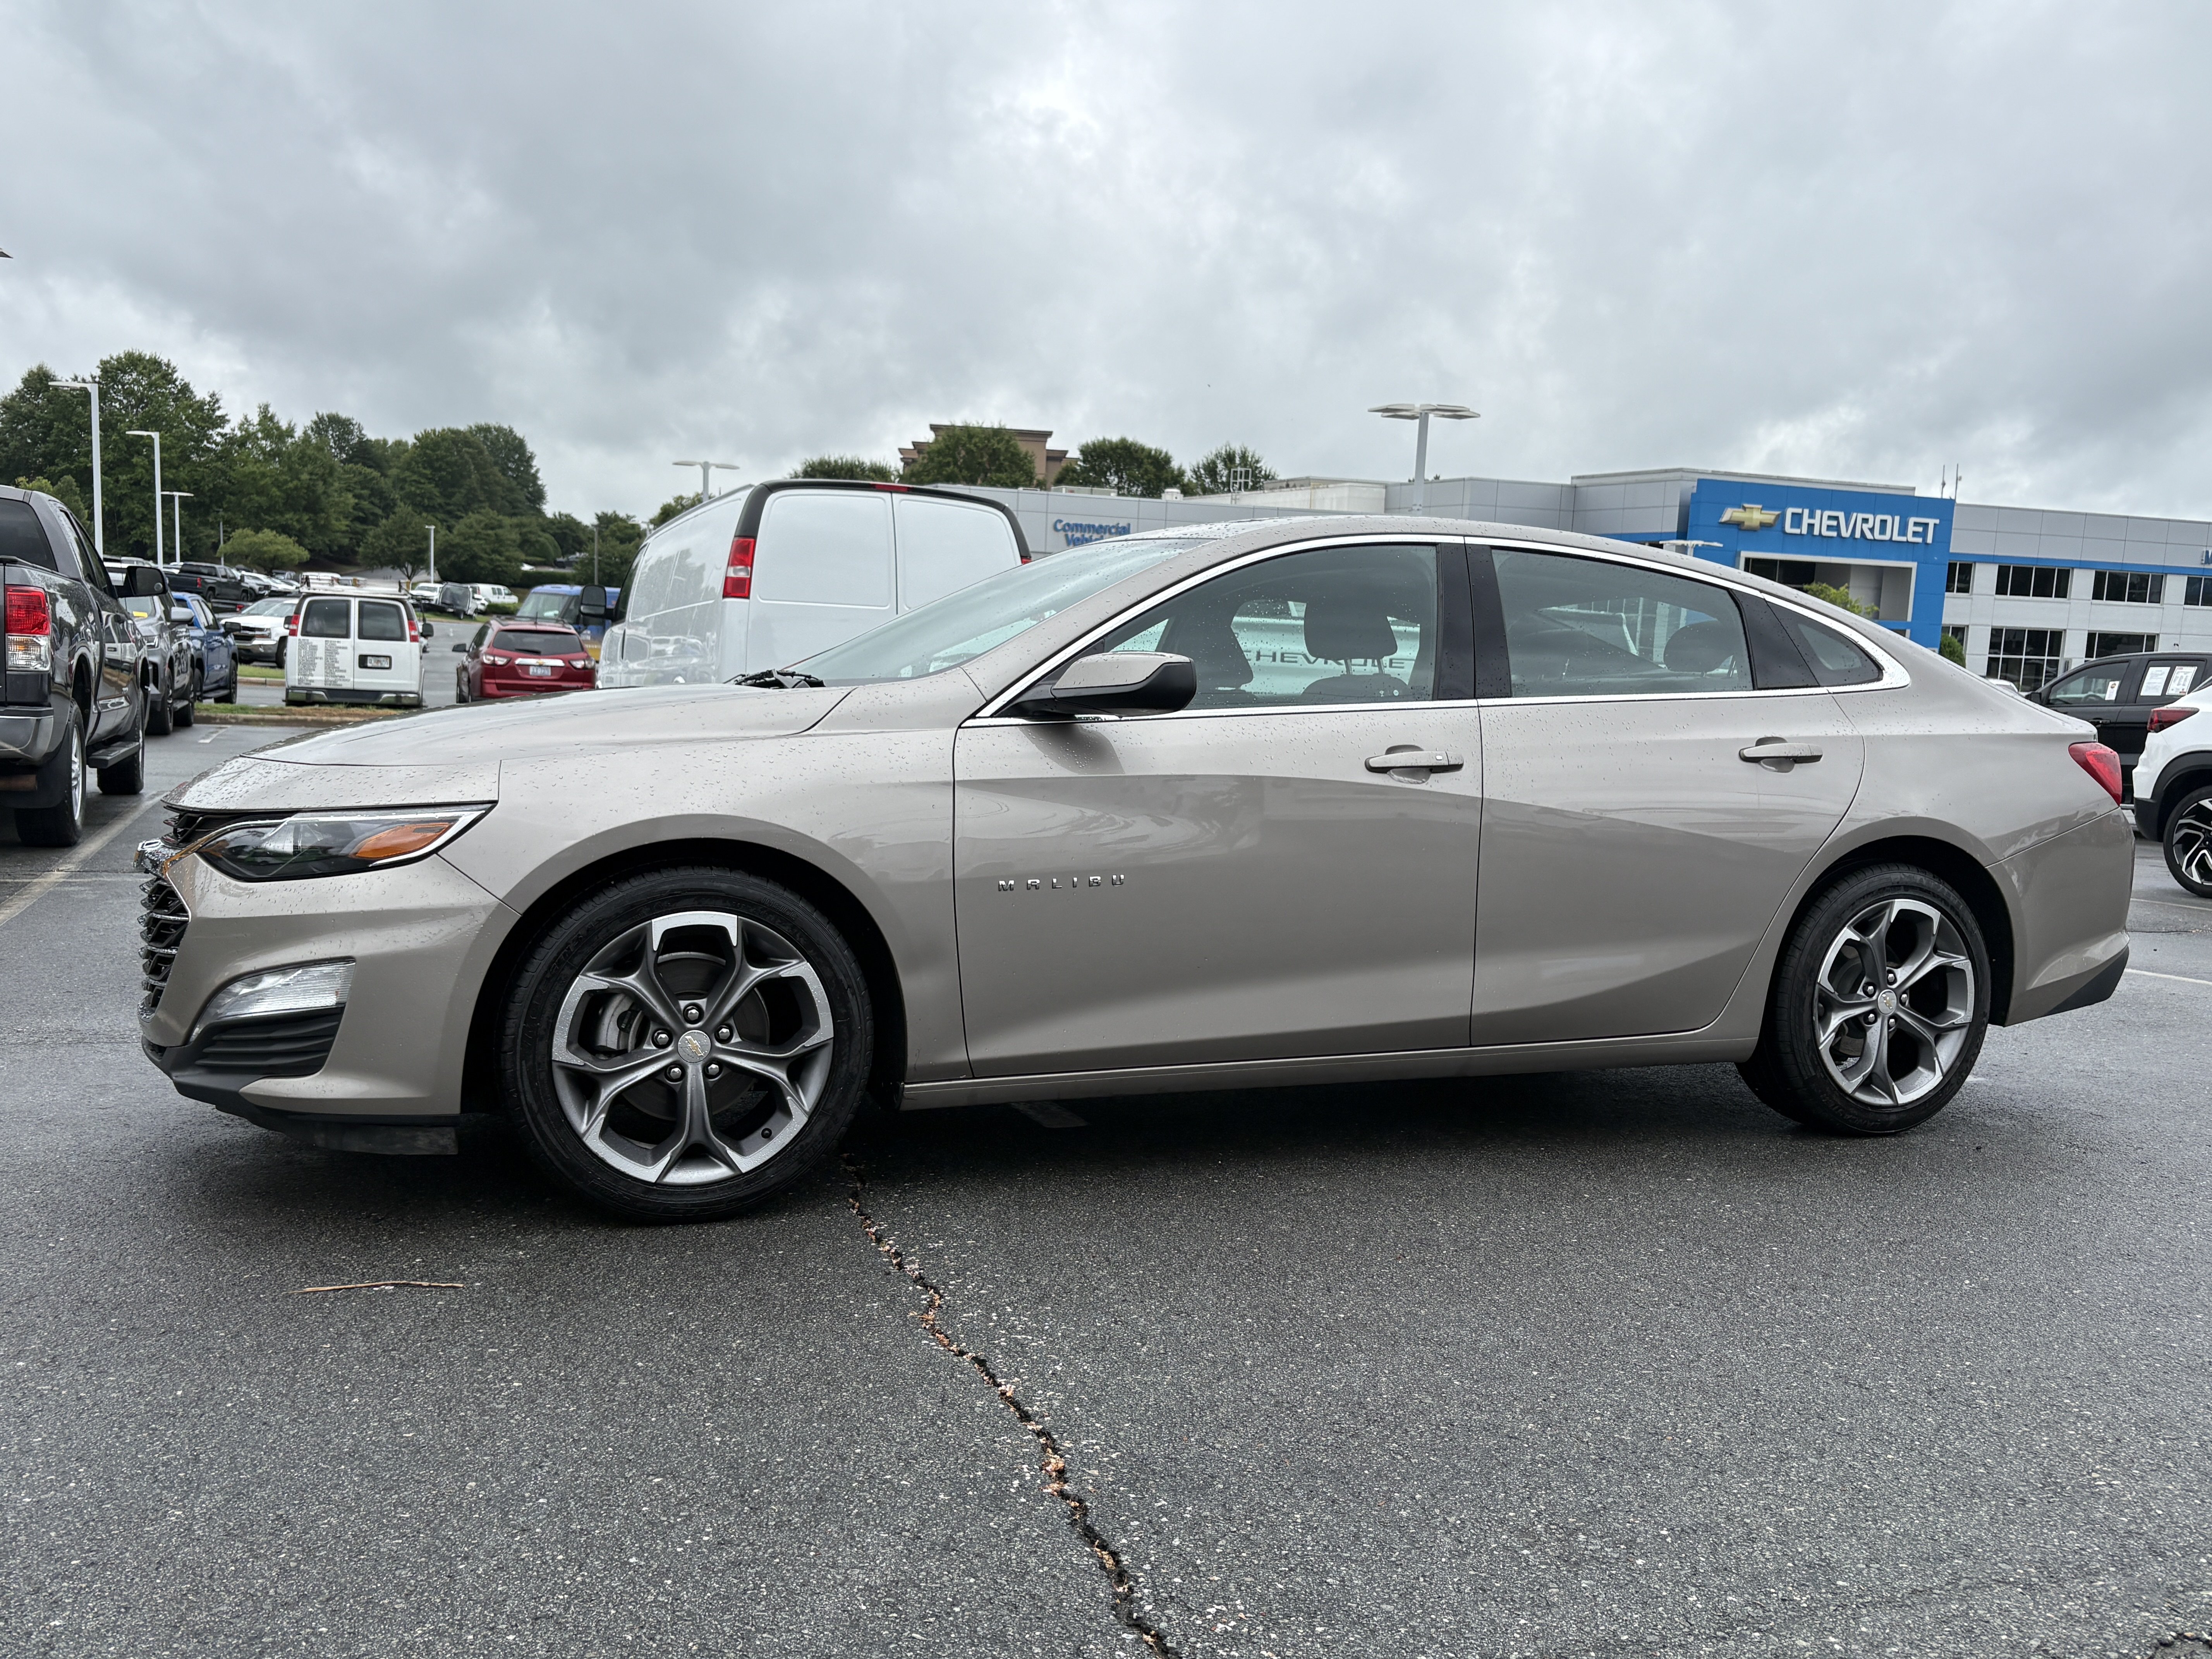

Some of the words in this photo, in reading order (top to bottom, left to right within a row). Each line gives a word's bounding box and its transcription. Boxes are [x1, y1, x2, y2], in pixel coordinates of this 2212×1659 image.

[1054, 519, 1130, 536] Commercial
[1785, 507, 1939, 544] CHEVROLET
[998, 874, 1124, 891] MALIBU
